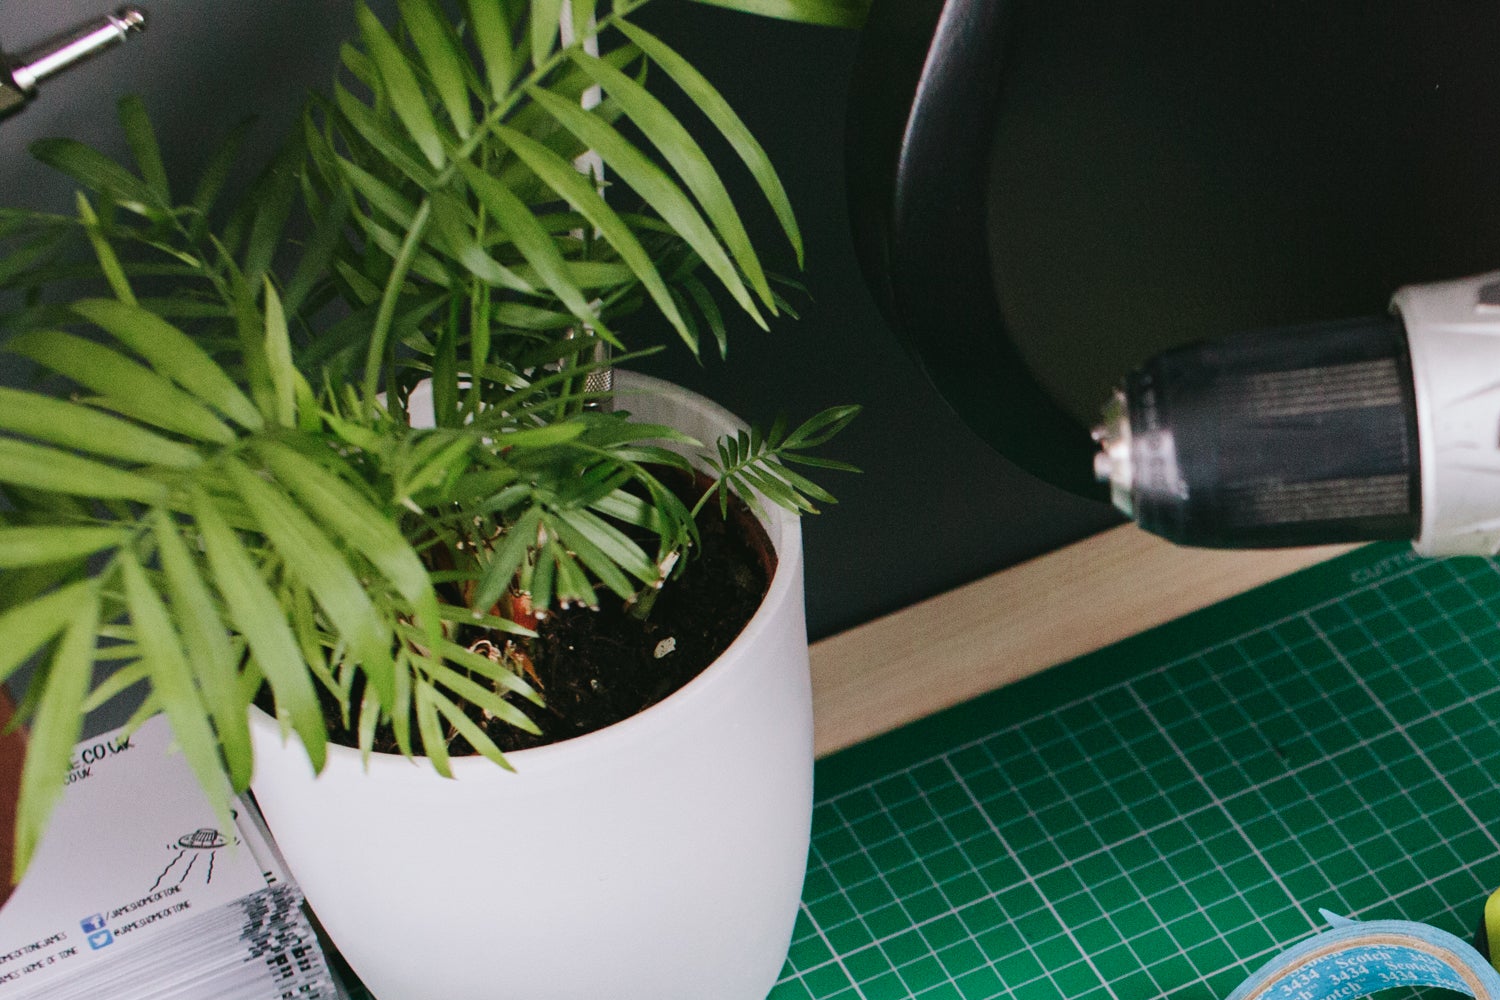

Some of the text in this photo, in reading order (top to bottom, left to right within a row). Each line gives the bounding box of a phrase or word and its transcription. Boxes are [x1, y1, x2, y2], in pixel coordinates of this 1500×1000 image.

[1280, 969, 1320, 997] 3434
[1328, 965, 1369, 986] 3434
[1378, 970, 1418, 983] 3434
